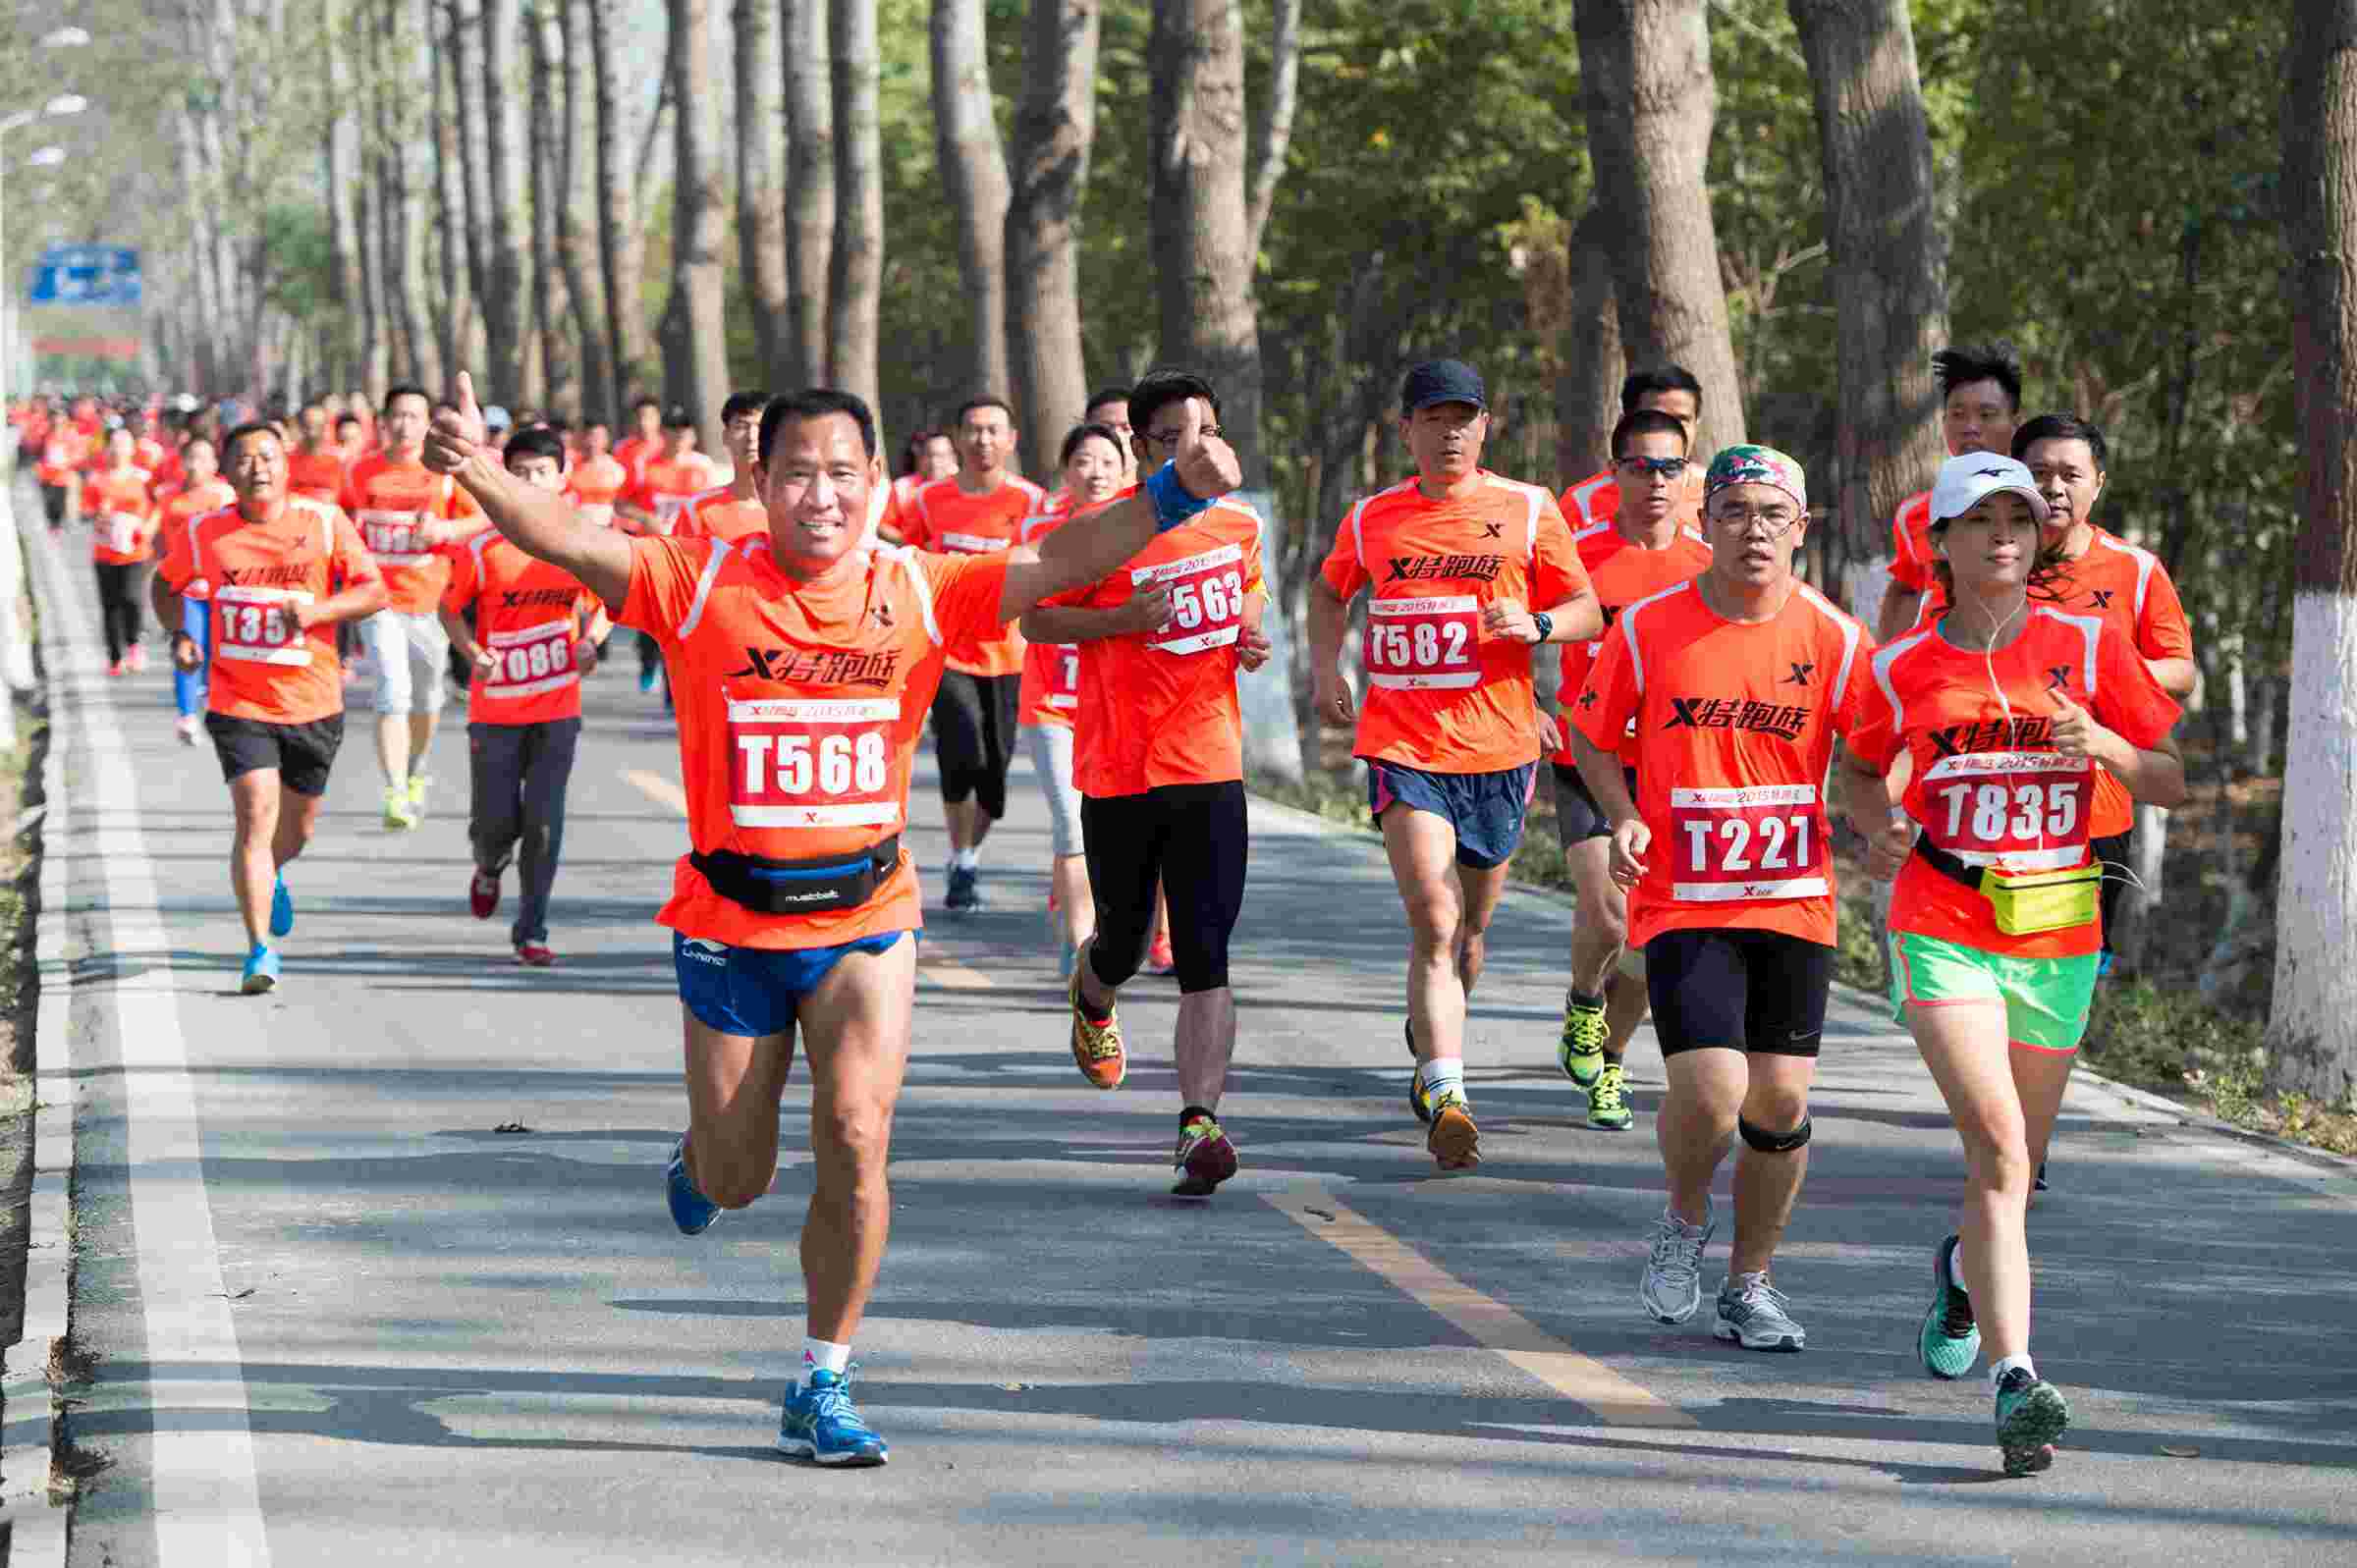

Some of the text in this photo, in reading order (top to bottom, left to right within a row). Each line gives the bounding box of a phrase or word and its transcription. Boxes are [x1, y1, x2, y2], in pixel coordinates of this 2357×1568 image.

[220, 604, 286, 645] T35
[1172, 569, 1242, 629] 563
[1371, 621, 1469, 668] T582
[1662, 696, 1814, 742] X特跑族
[1929, 716, 2054, 758] X特跑
[739, 731, 887, 794] T568
[1939, 782, 2081, 841] T835
[1683, 816, 1809, 872] T221
